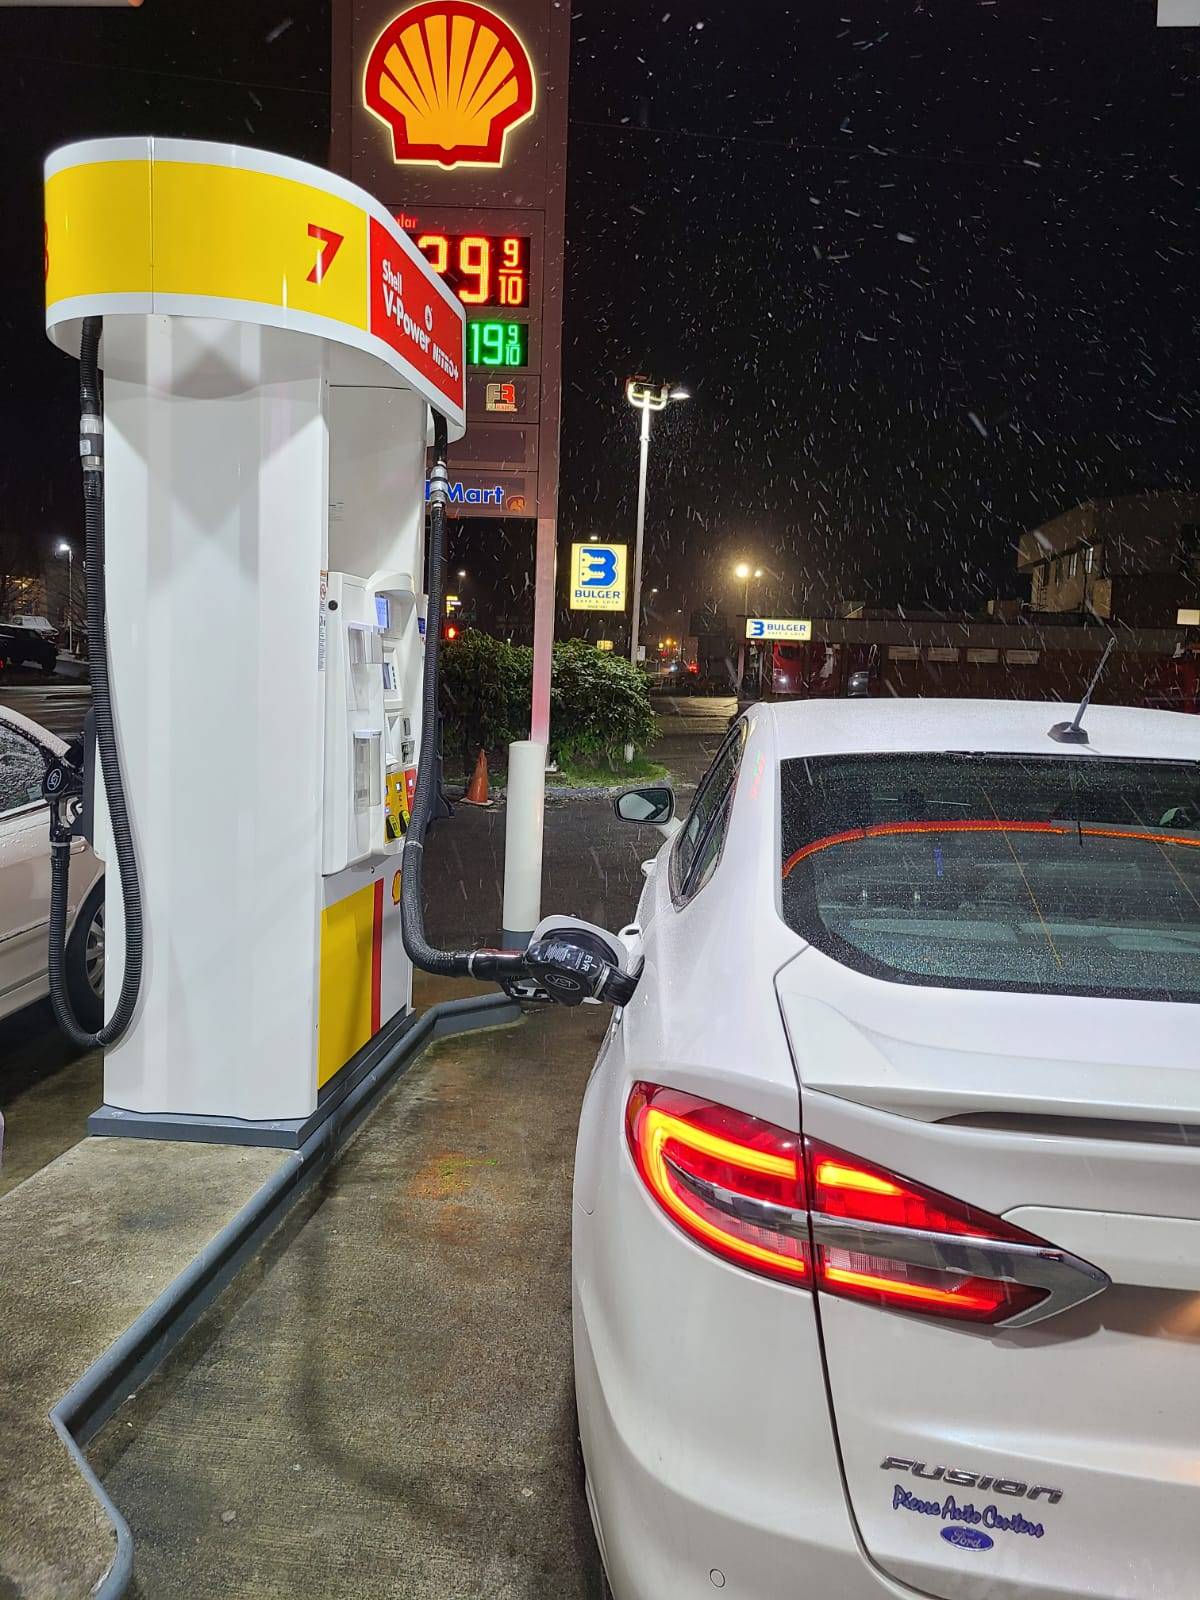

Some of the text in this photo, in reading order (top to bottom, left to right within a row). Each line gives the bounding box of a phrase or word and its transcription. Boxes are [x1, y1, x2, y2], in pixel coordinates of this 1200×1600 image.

[306, 223, 344, 283] 7
[382, 258, 403, 296] Shell
[382, 282, 431, 353] V-Power
[447, 482, 504, 505] Mart
[574, 589, 621, 599] BULGER
[767, 623, 807, 631] BULGER
[941, 1495, 982, 1524] Auto
[982, 1505, 1044, 1538] Centers
[950, 1531, 982, 1548] Ford
